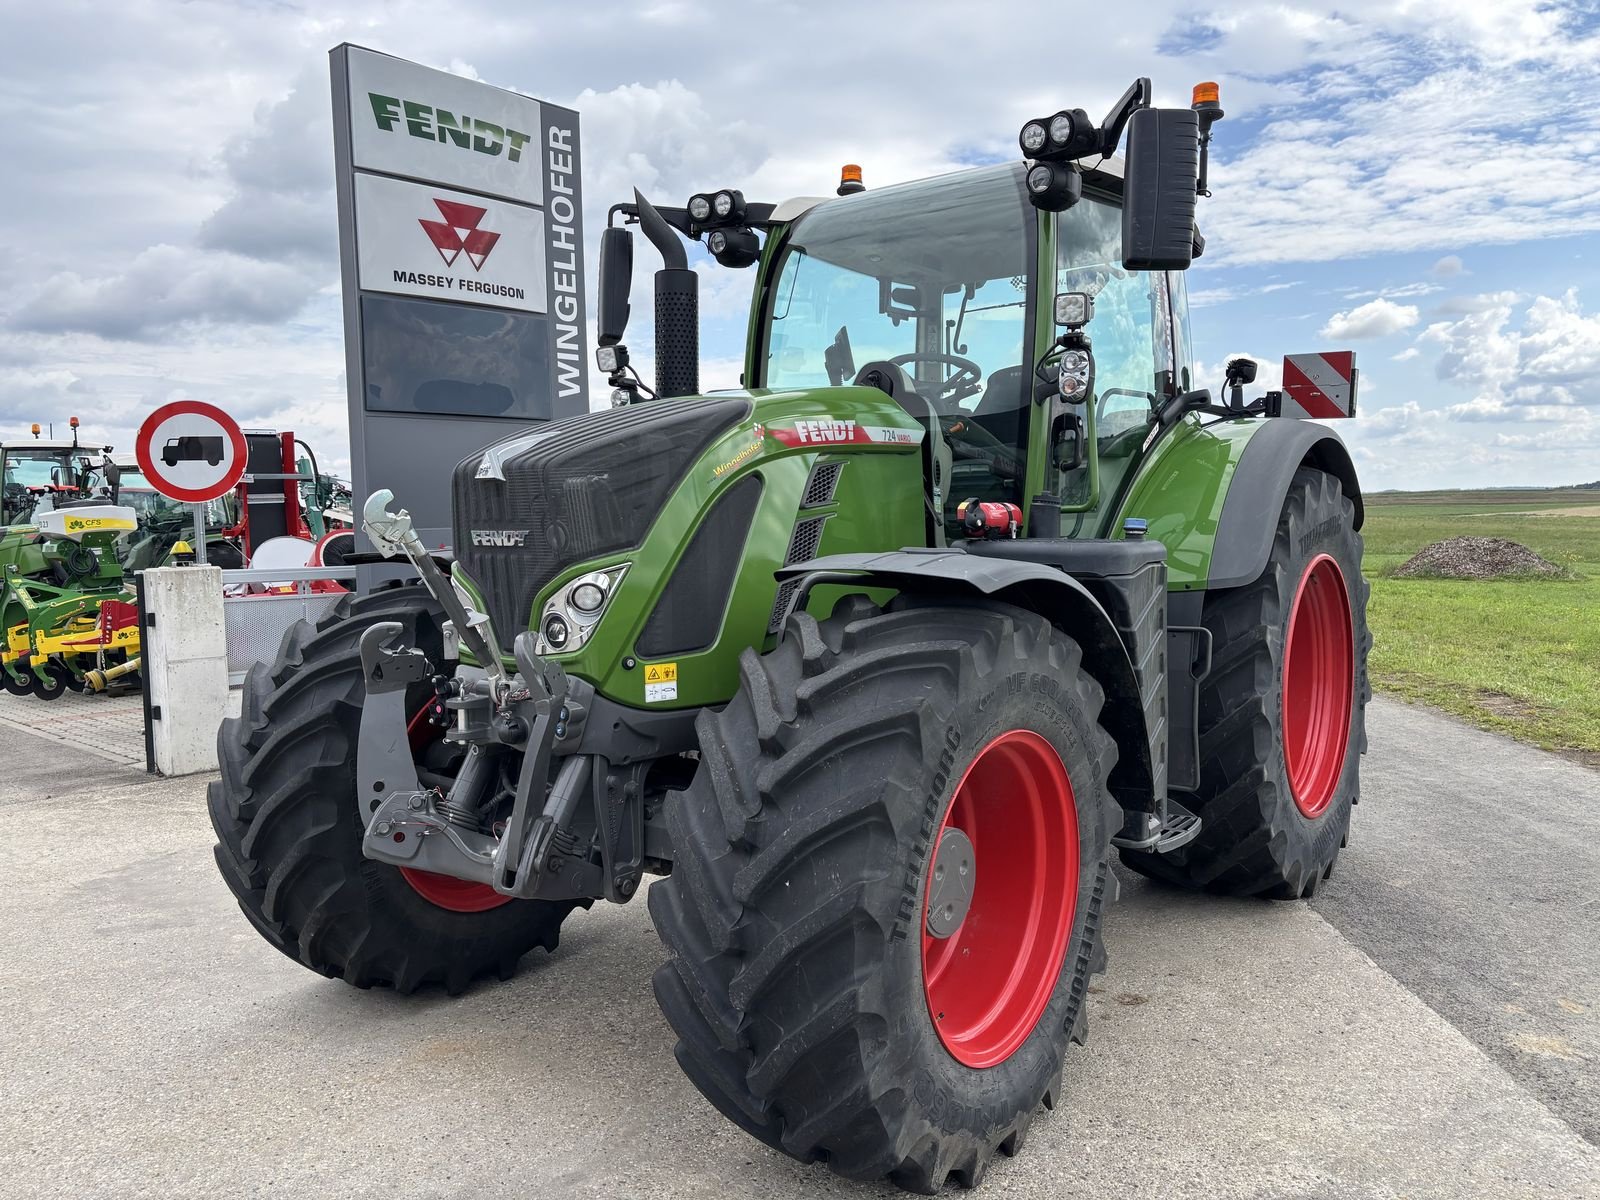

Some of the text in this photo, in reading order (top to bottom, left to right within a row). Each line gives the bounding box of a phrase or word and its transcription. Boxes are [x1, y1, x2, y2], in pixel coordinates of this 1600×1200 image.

[368, 92, 531, 163] FENDT
[393, 270, 525, 300] MASSEY FERGUSON
[549, 125, 581, 398] WINGELHOFER
[794, 420, 856, 442] FENDT
[882, 429, 897, 442] 724
[471, 530, 530, 546] FENDT
[889, 725, 961, 944] TRELLEBORG
[1063, 861, 1108, 1036] TRELLEBORG
